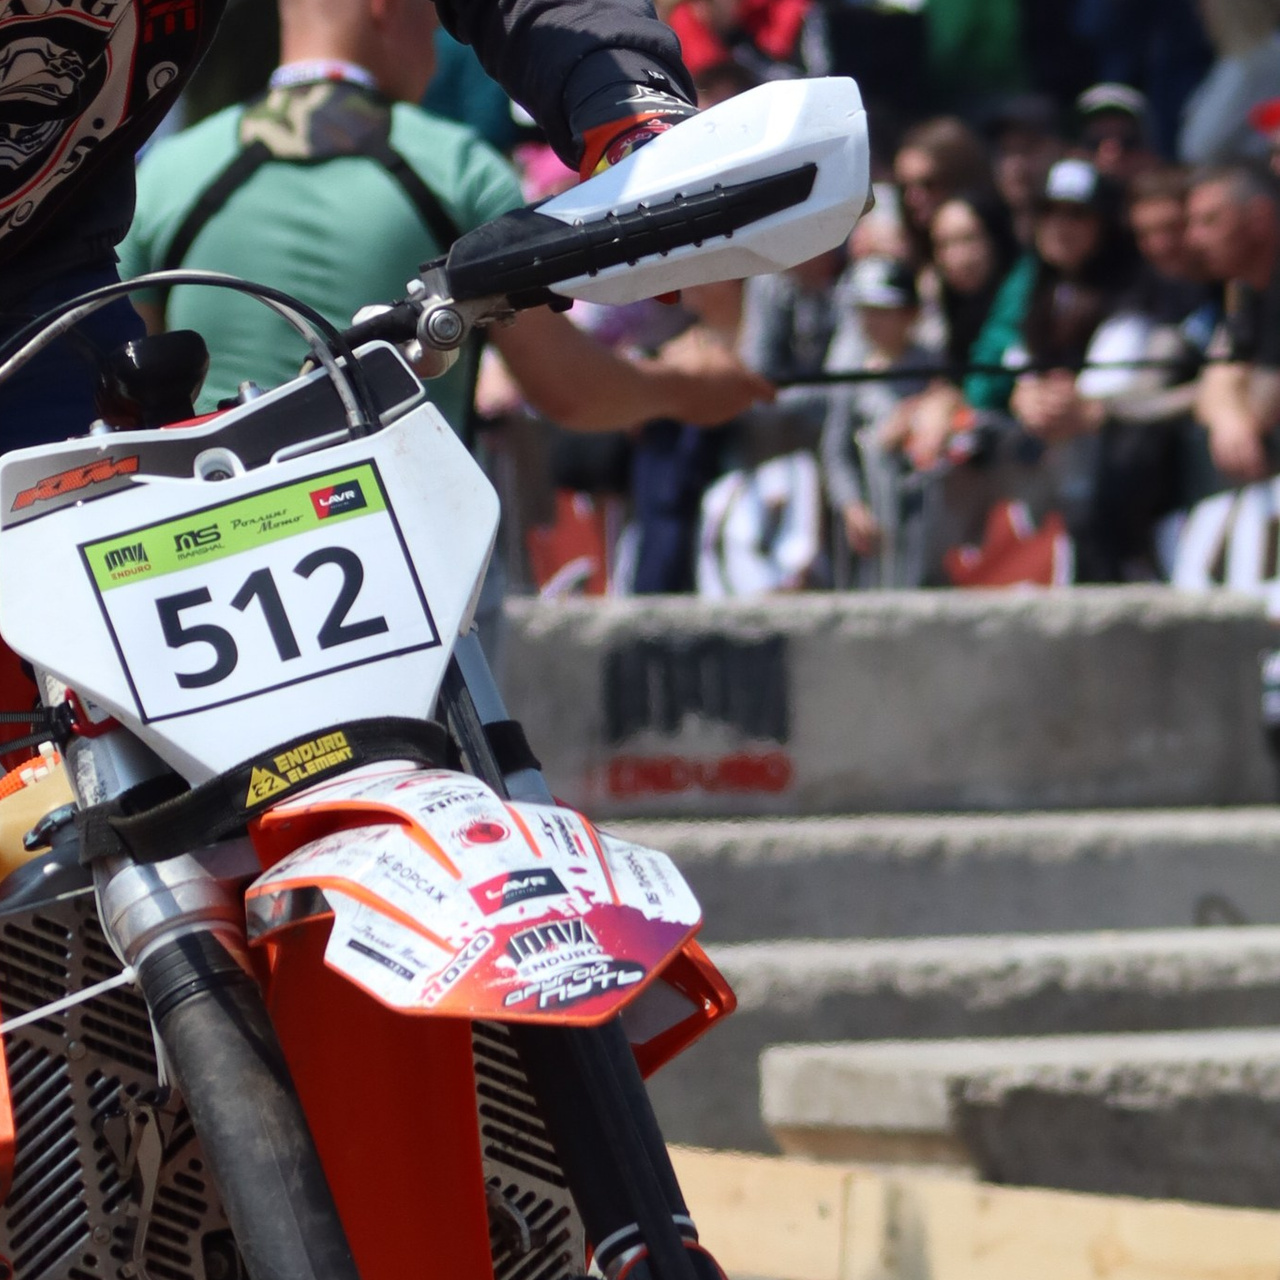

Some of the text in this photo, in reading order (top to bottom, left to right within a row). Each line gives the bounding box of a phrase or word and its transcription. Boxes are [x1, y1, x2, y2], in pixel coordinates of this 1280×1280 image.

[10, 455, 140, 513] KTM
[319, 489, 356, 507] LAVR
[177, 543, 226, 561] MARSHAL
[111, 563, 152, 581] ENDURO
[155, 545, 389, 690] 512
[273, 731, 349, 775] ENDURO
[286, 746, 354, 784] ELEMENT
[485, 875, 548, 901] LAVR
[505, 961, 609, 1007] ДРУГОЙ
[540, 969, 644, 1009] ПУТЬ
